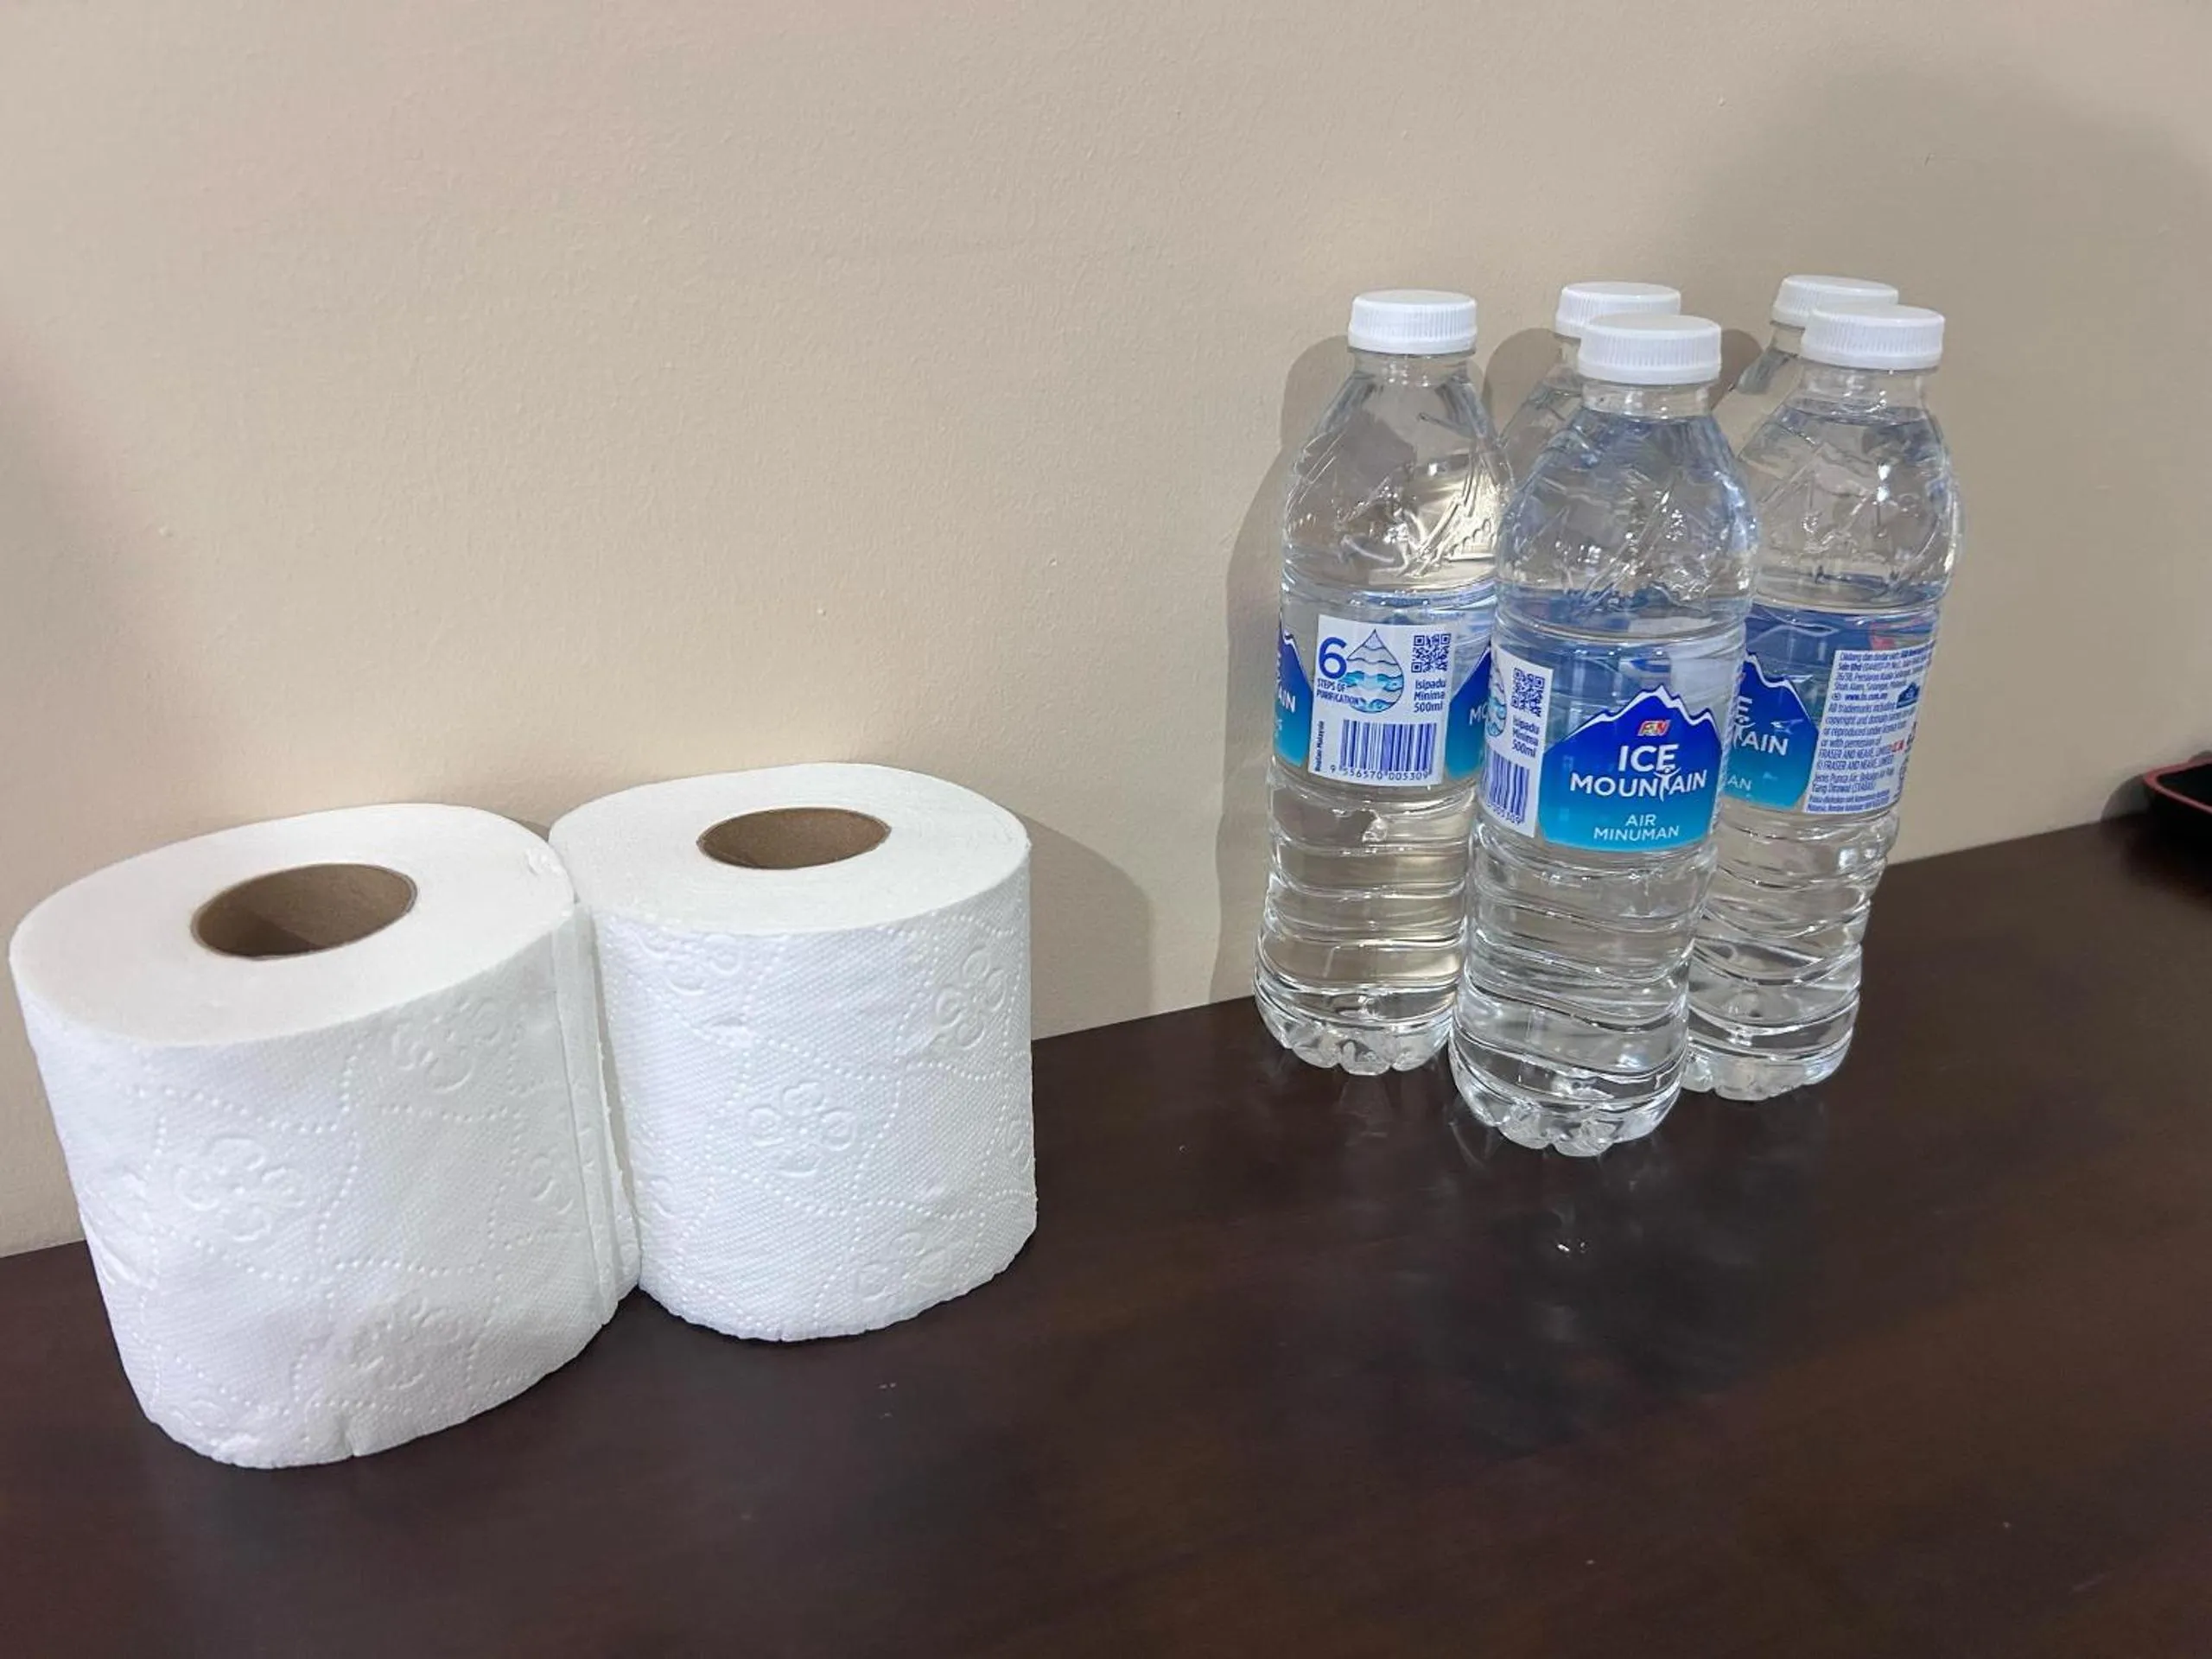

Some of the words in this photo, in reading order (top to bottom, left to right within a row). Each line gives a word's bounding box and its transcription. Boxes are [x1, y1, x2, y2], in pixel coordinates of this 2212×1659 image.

[1319, 637, 1347, 679] 6
[1317, 677, 1337, 691] STEPS
[1337, 680, 1346, 692] OF
[1415, 678, 1446, 691] Isipadu
[1316, 690, 1361, 706] PURIFICATION
[1414, 690, 1446, 702] Minima
[1414, 702, 1444, 713] 500ml
[1618, 744, 1680, 772] ICE
[1330, 765, 1336, 774] 9
[1569, 769, 1708, 802] MOUNTAIN
[1625, 815, 1656, 826] AIR
[1592, 825, 1680, 842] MINUMAN
